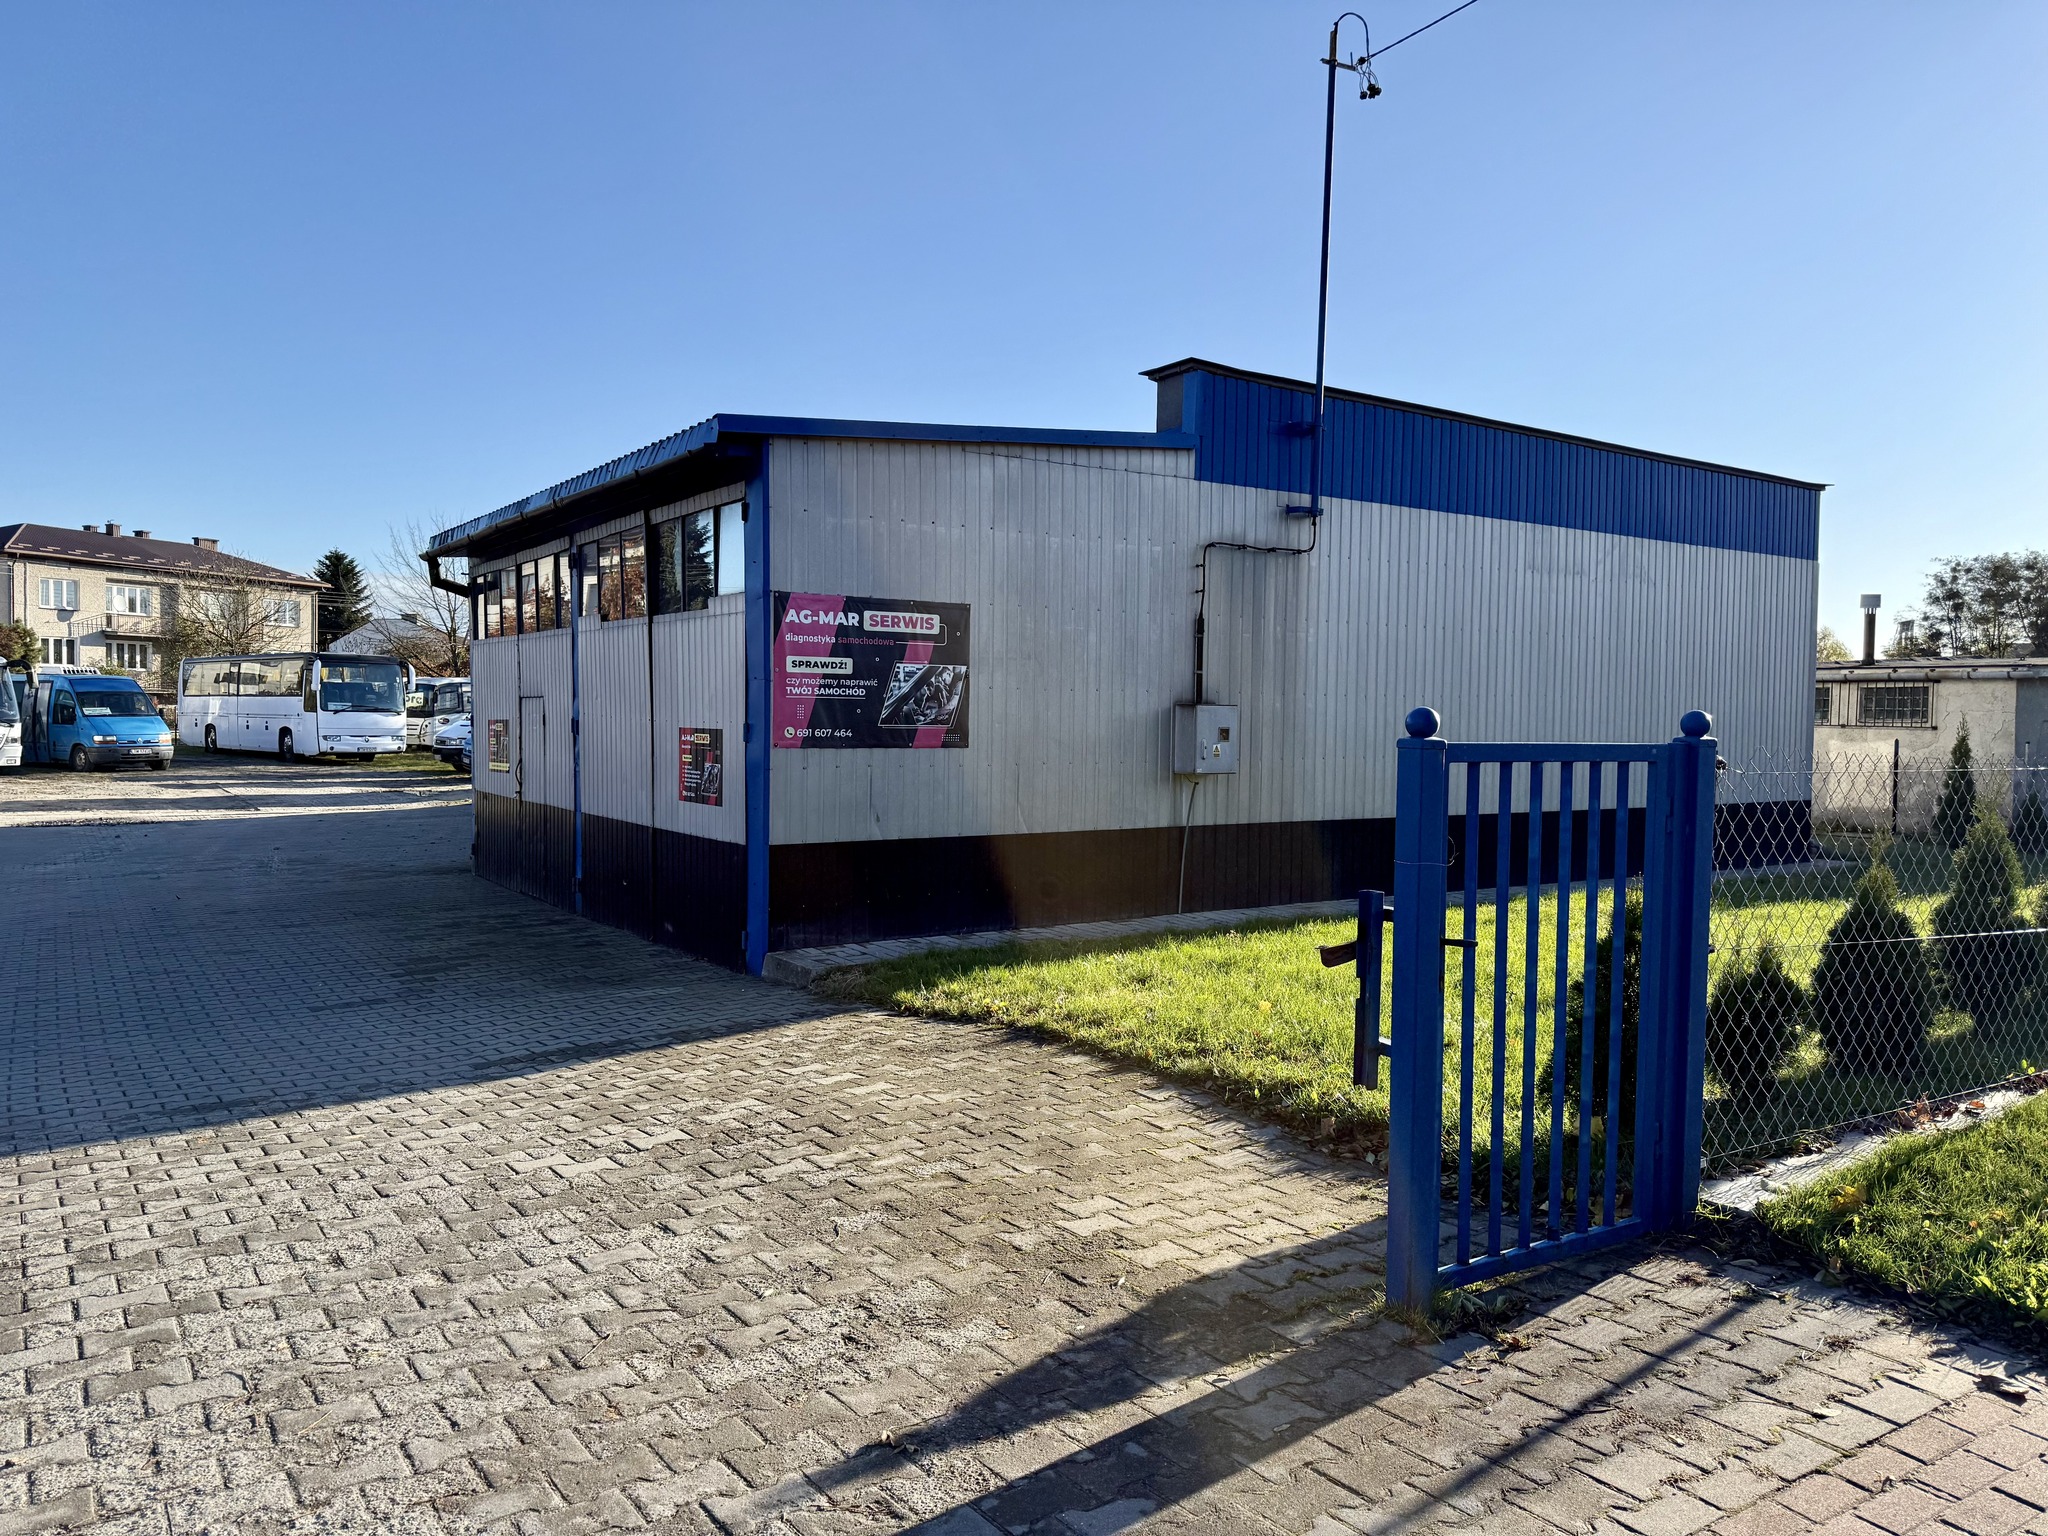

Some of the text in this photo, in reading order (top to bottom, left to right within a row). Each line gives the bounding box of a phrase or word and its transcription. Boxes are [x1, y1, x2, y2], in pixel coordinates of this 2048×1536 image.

[785, 609, 935, 631] AG-MAR SERWIS
[785, 632, 895, 646] diagnostyka samochodowa
[791, 659, 848, 670] SPRAWDŹ!
[785, 676, 878, 687] czy możemy naprawić
[785, 685, 866, 696] TWÓJ SAMOCHÓD
[796, 728, 853, 738] 691 607 464
